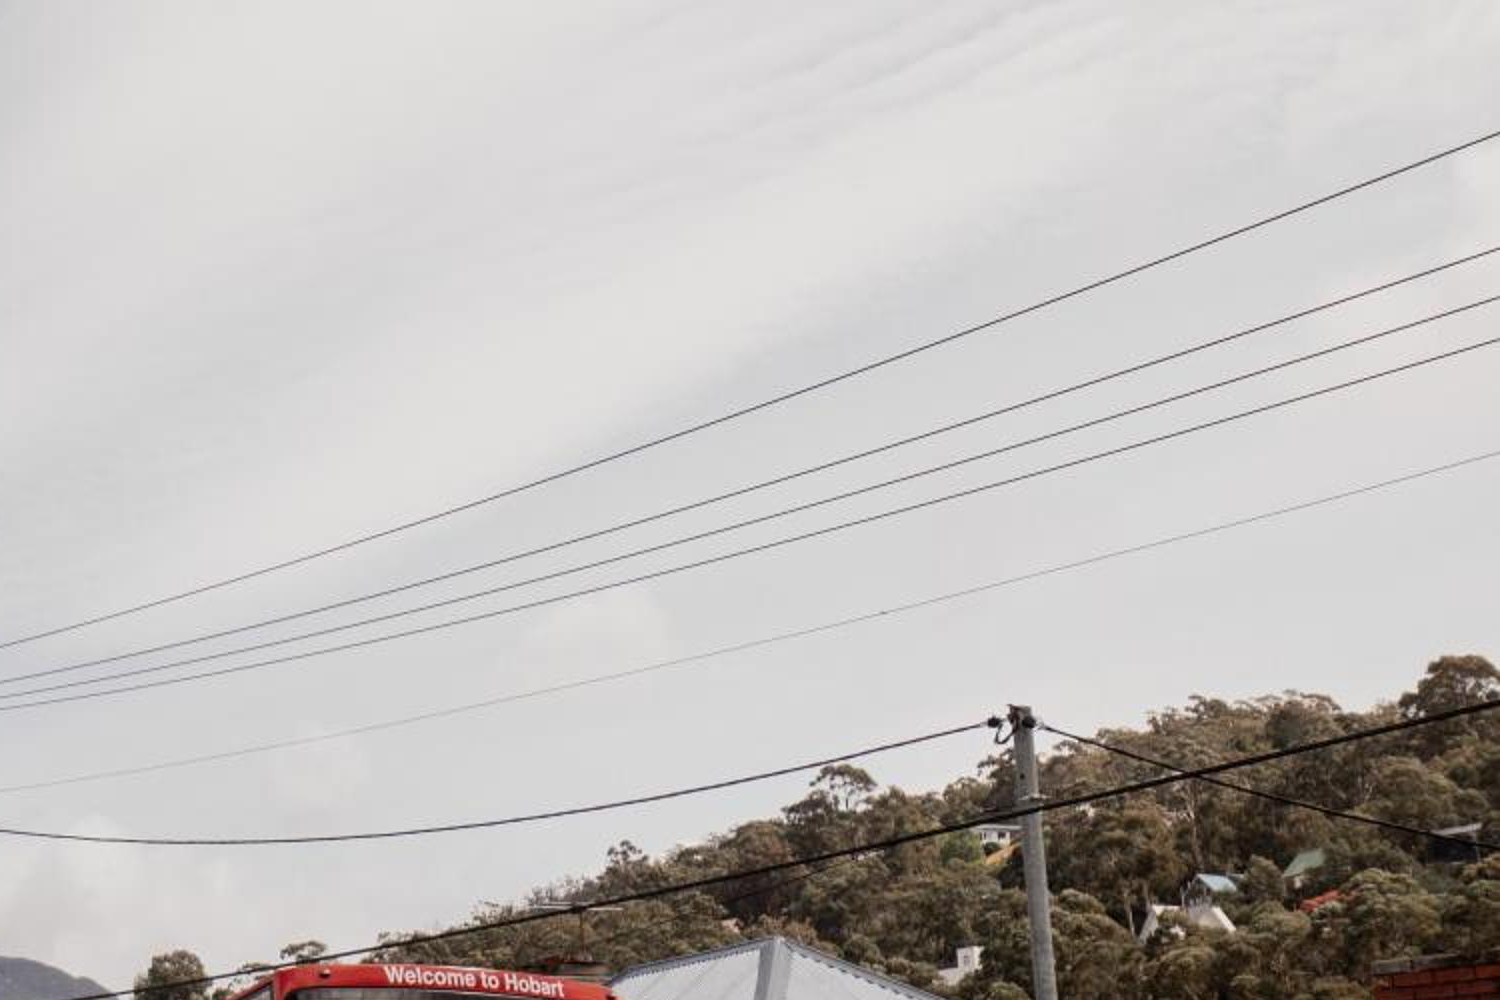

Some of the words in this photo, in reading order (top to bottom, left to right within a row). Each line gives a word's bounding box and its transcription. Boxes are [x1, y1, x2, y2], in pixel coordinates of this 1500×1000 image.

[383, 965, 476, 987] Welcome
[480, 972, 499, 989] to
[504, 973, 565, 998] Hobart
